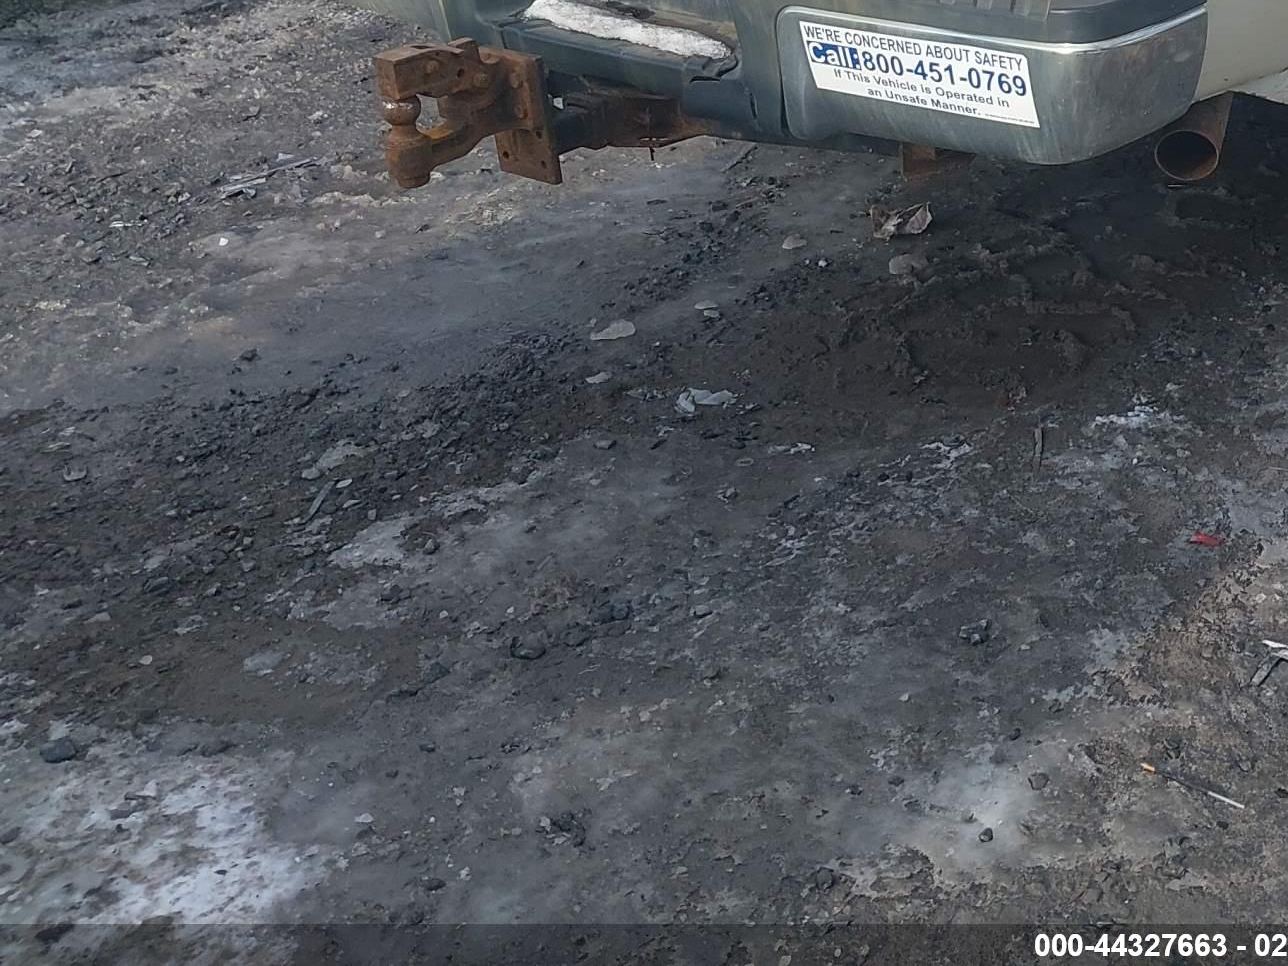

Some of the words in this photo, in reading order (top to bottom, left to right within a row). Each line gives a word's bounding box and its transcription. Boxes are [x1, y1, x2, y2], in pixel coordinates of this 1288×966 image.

[803, 25, 841, 43] WE'RE
[844, 31, 923, 56] CONCERNED
[925, 44, 971, 63] ABOUT
[974, 50, 1024, 72] SAFETY
[833, 68, 843, 79] If
[844, 70, 871, 84] This
[873, 75, 918, 92] Vehicle
[935, 86, 994, 106] Operated
[861, 50, 1027, 97] 800-451-0769
[867, 87, 882, 98] an
[884, 89, 928, 107] Unsafe
[930, 97, 982, 117] Manner.
